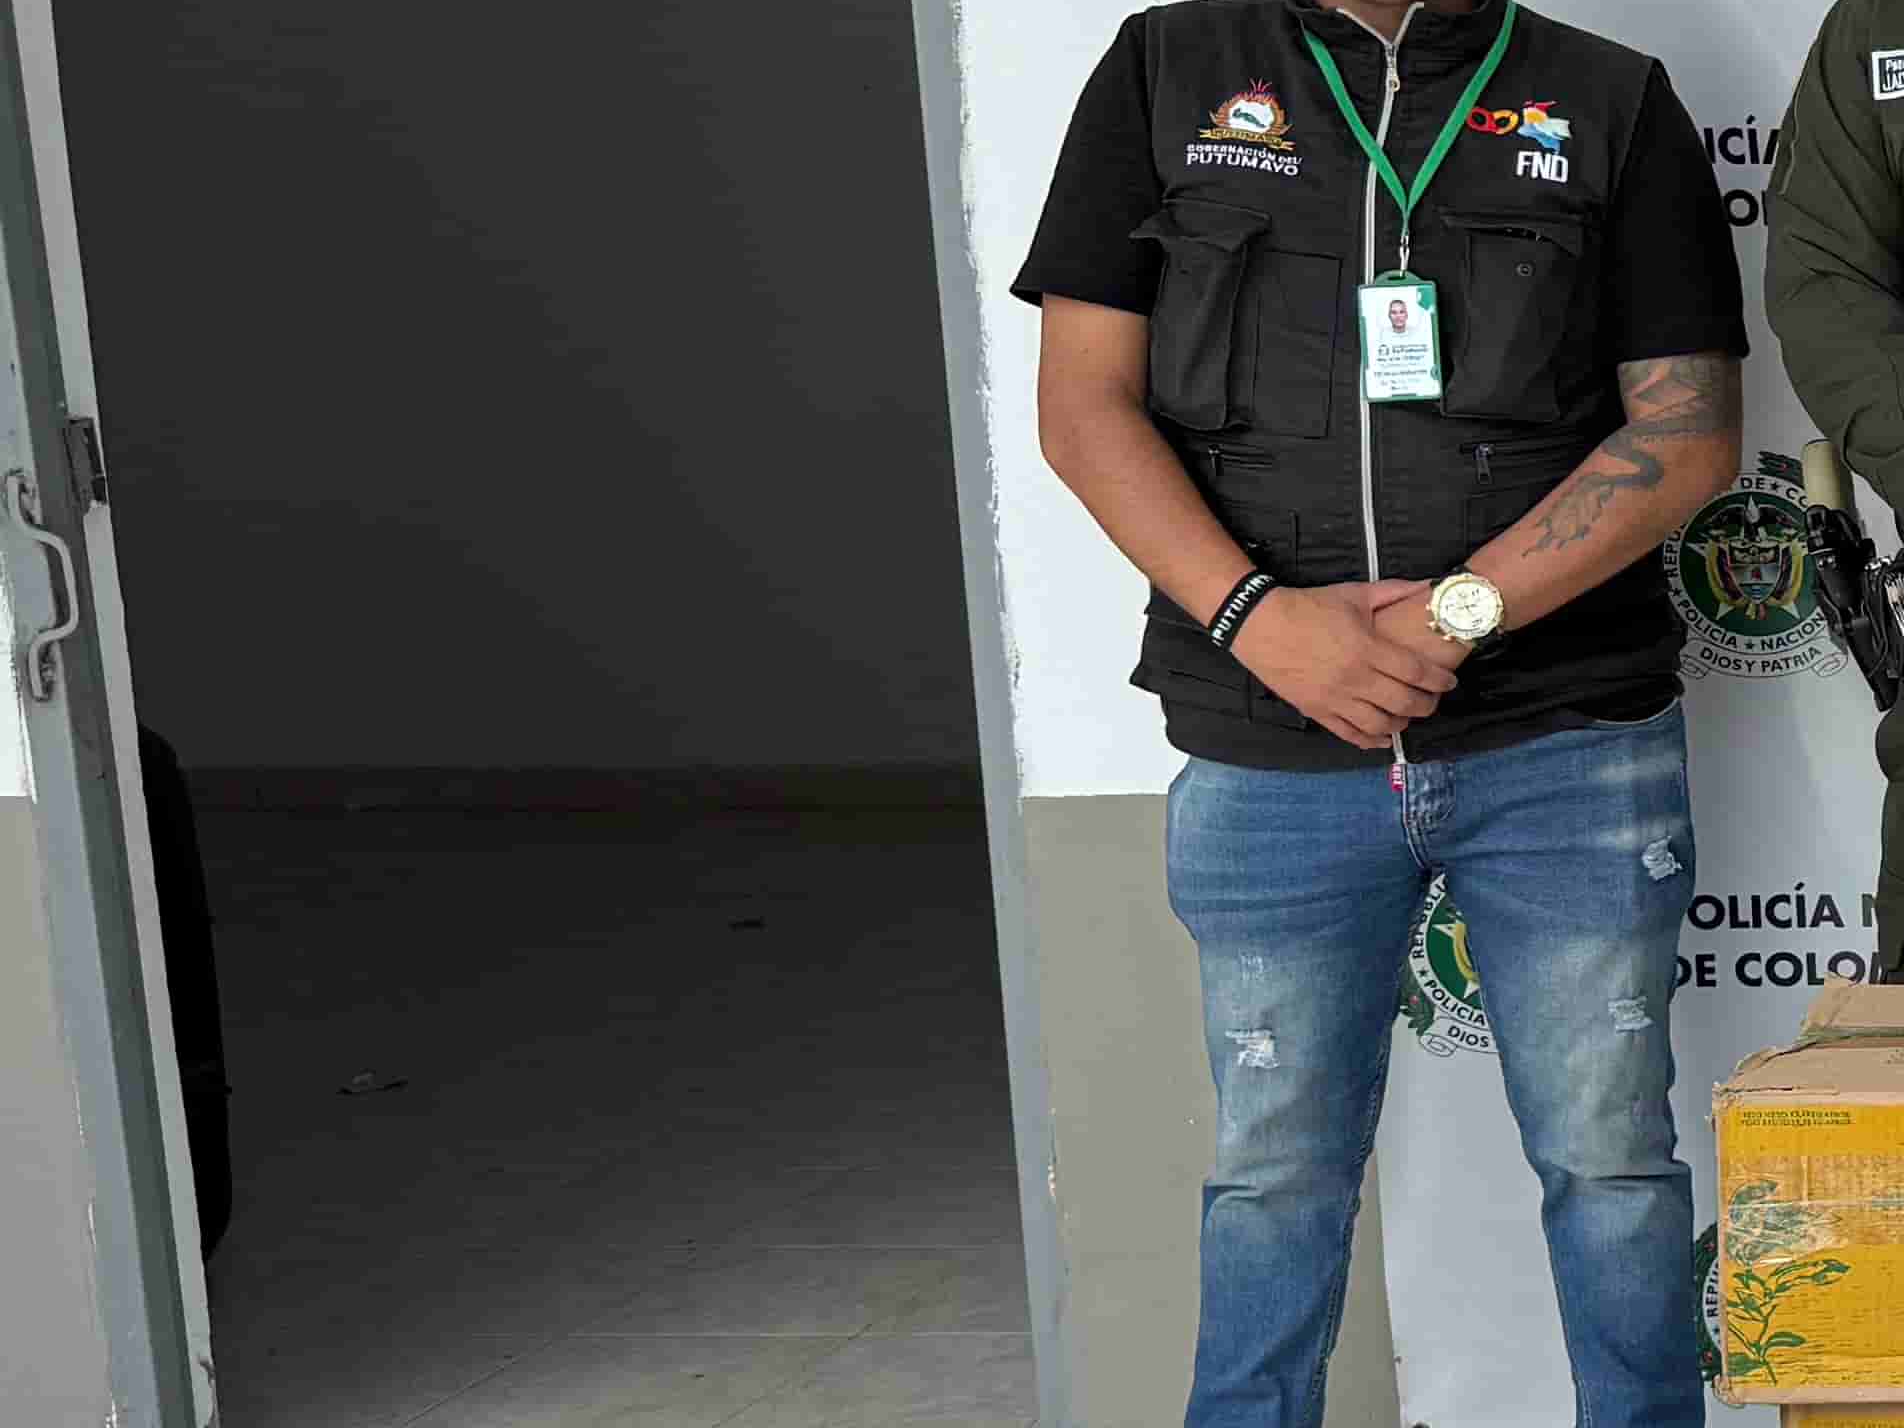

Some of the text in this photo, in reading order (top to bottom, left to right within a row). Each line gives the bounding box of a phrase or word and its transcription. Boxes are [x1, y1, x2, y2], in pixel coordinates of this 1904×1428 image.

[1187, 152, 1299, 176] PUTUMAYO
[1516, 151, 1569, 183] FND
[1687, 882, 1841, 933] OLICÍA
